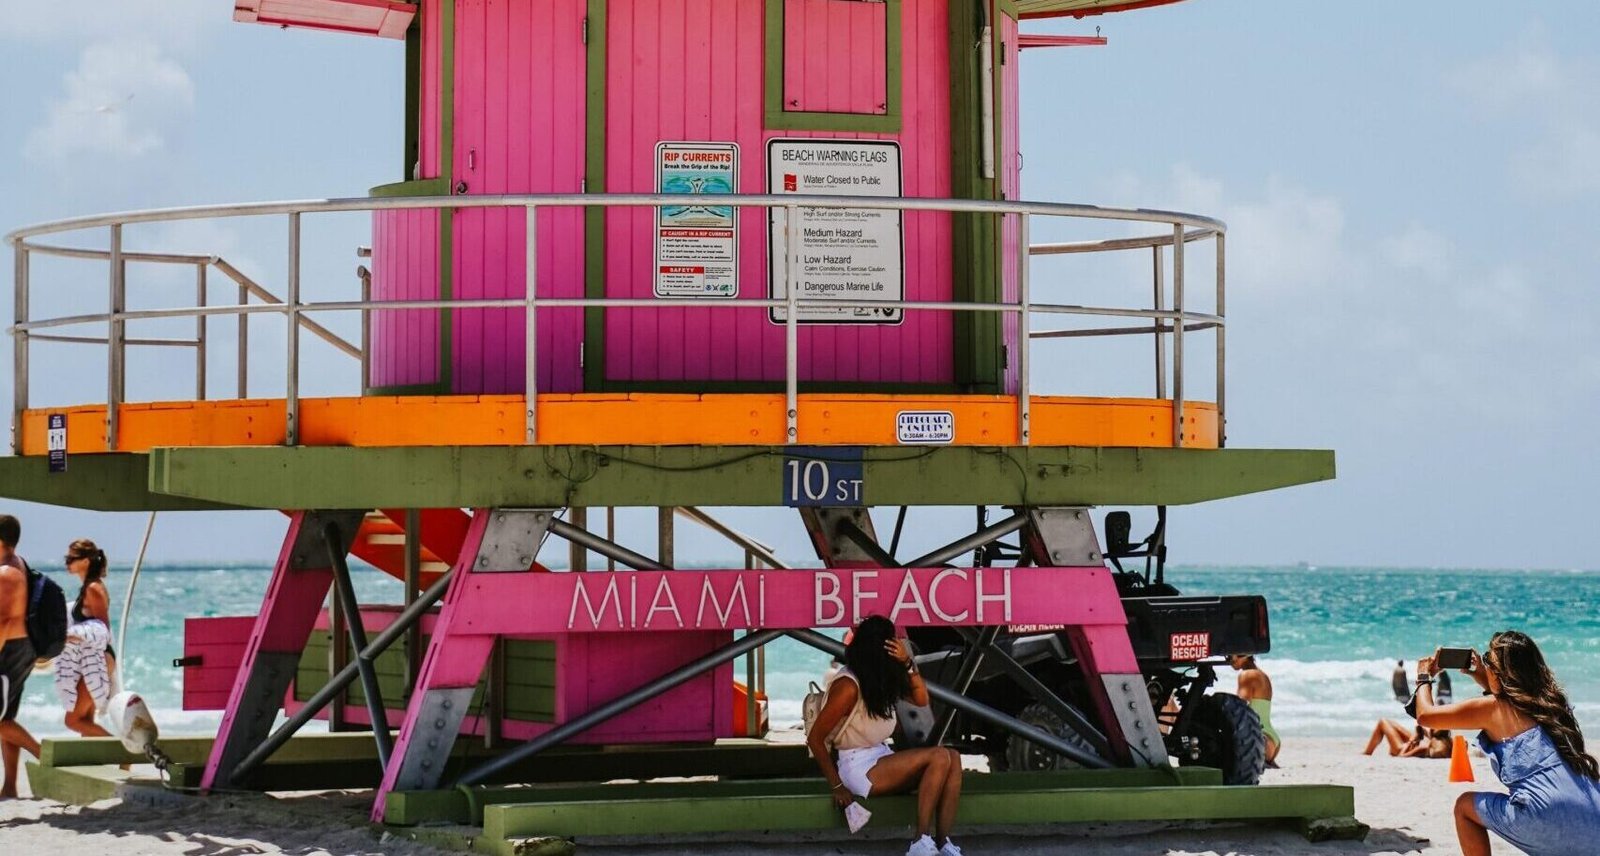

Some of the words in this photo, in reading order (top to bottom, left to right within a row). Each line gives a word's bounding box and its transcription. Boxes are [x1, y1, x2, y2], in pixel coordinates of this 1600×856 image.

[682, 153, 731, 162] CURRENTS
[782, 150, 814, 161] BEACH
[816, 150, 858, 162] WARNING
[860, 151, 888, 162] FLAGS
[803, 175, 825, 184] Water
[827, 175, 851, 184] Closed
[861, 176, 880, 185] Public
[804, 229, 833, 237] Medium
[836, 229, 862, 237] Hazard
[804, 255, 820, 264] Low
[823, 256, 851, 264] Hazard
[804, 282, 844, 292] Dangerous
[846, 282, 869, 291] Marine
[872, 282, 883, 291] Life
[788, 460, 829, 500] 10
[836, 480, 863, 501] ST
[568, 574, 765, 629] MIAMI
[815, 569, 1012, 625] BEACH
[1172, 634, 1208, 646] OCEAN
[1172, 647, 1208, 659] RESCUE
